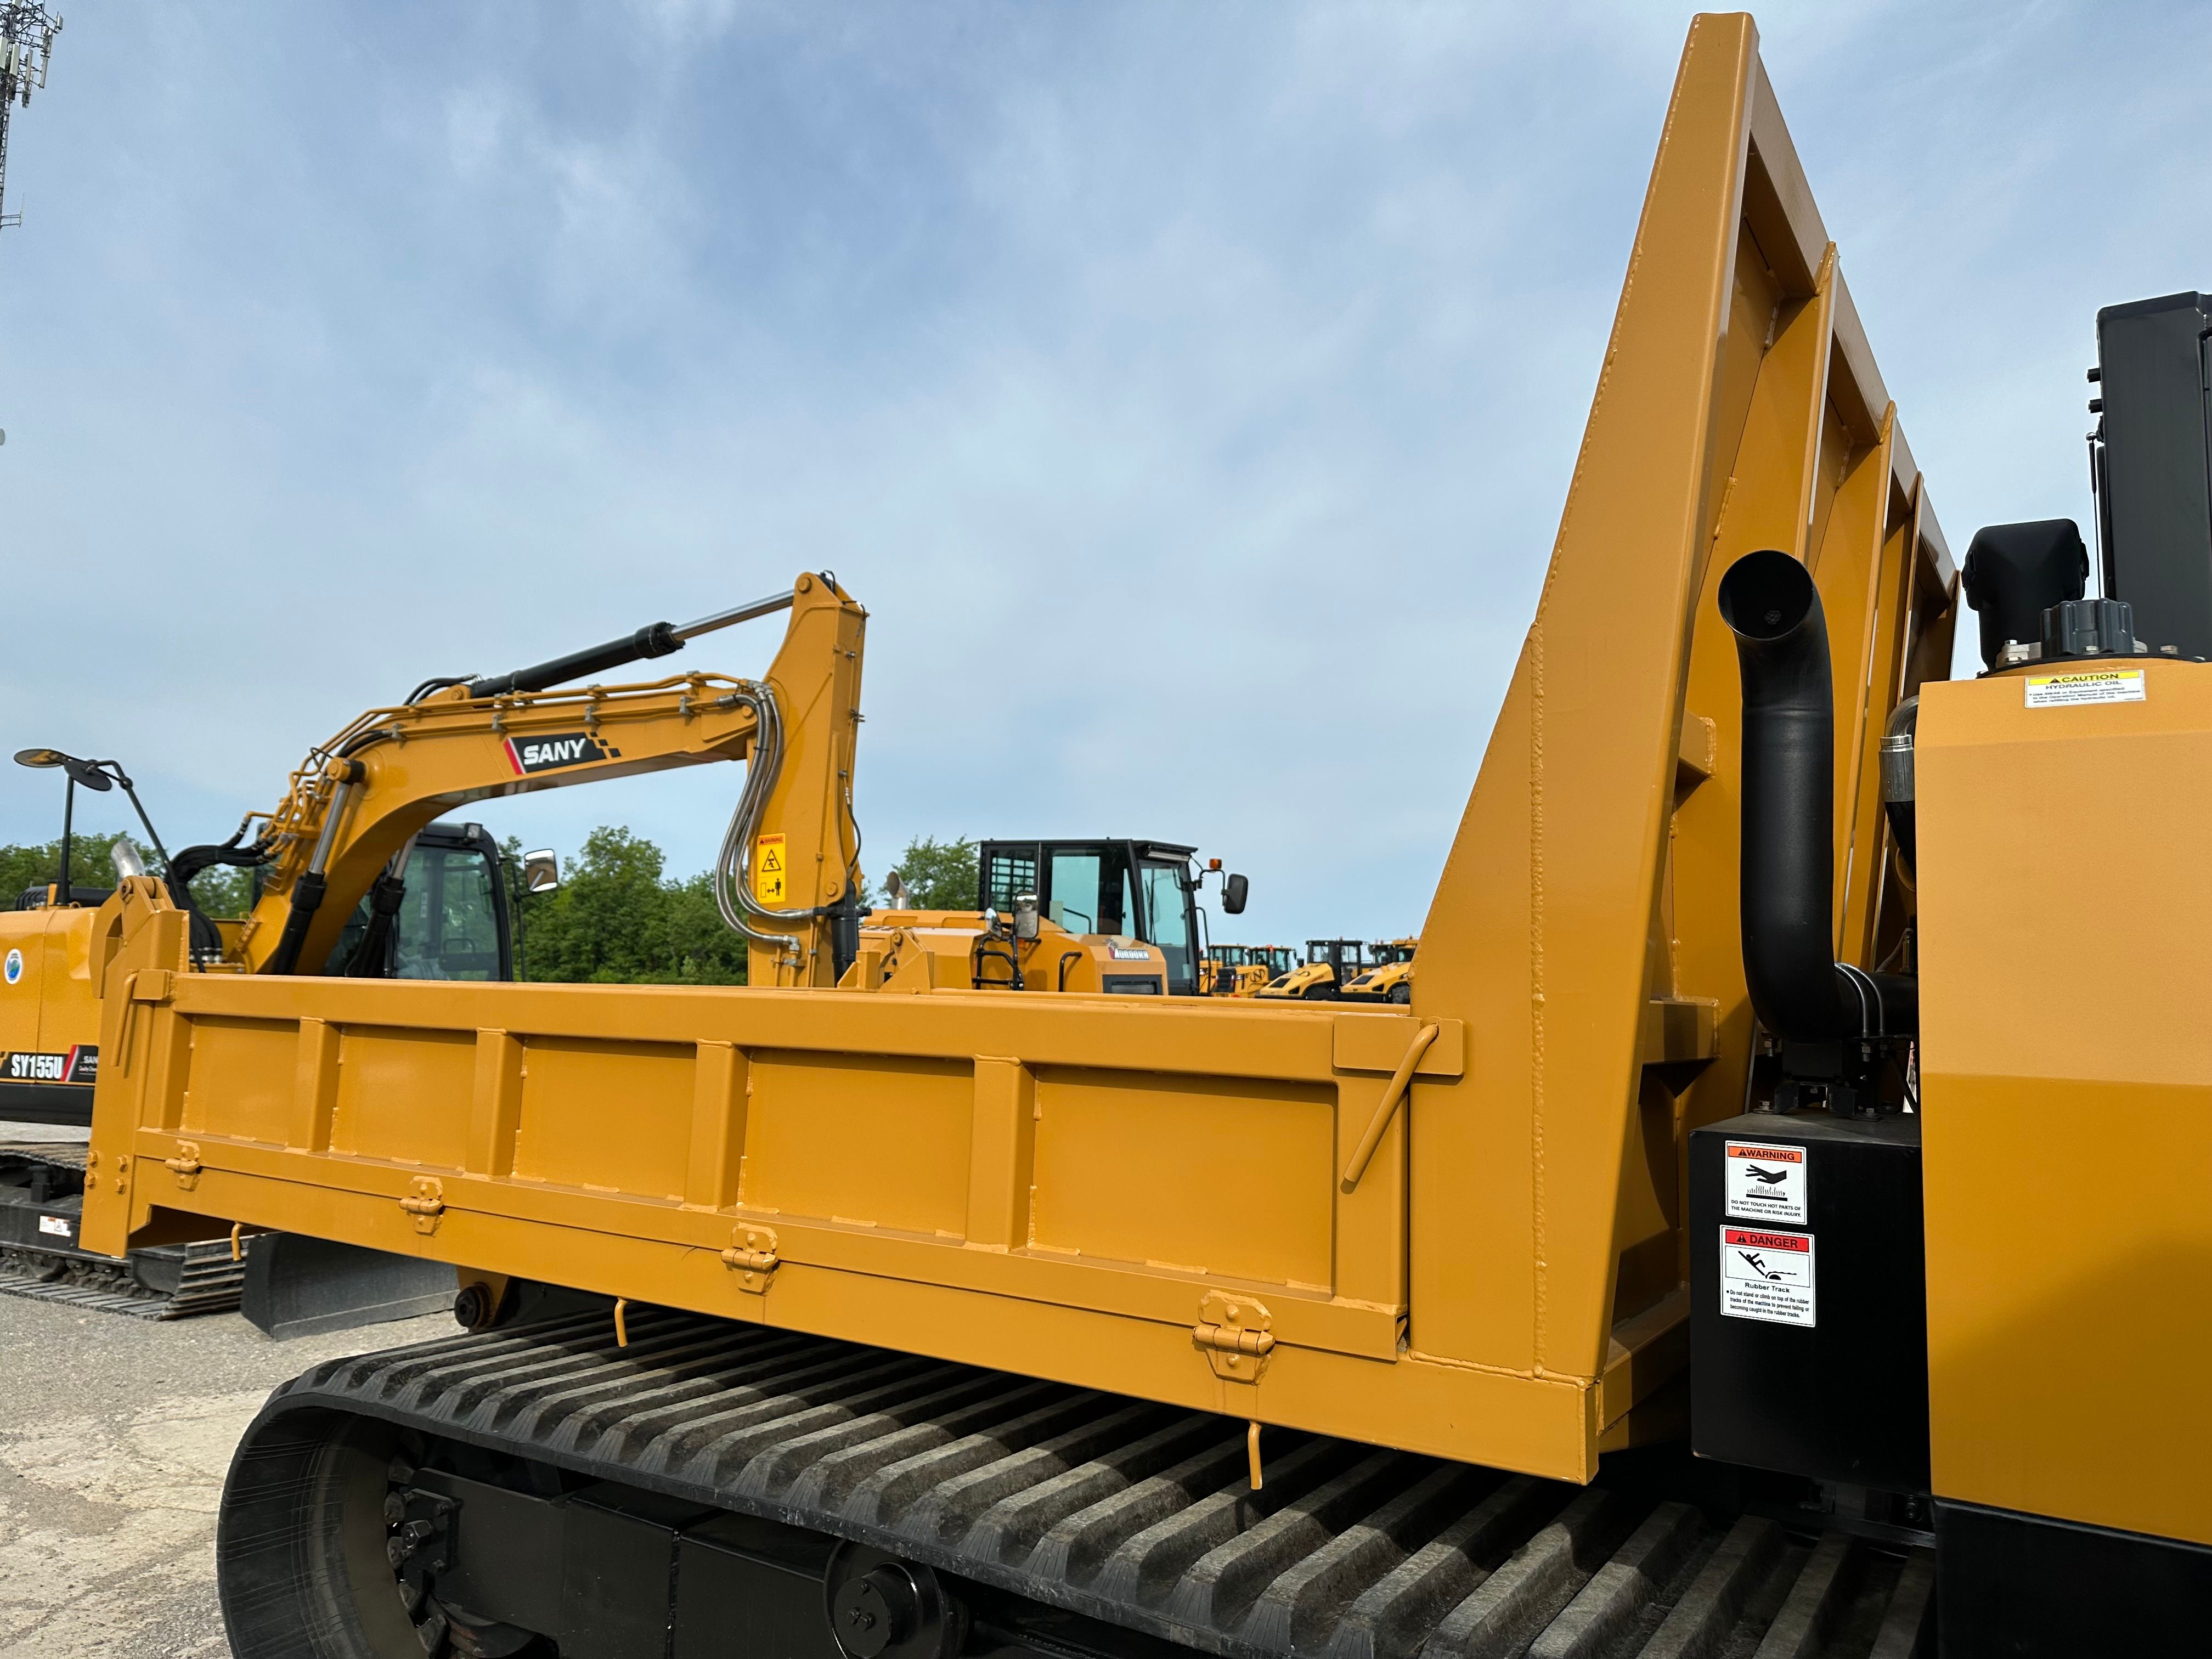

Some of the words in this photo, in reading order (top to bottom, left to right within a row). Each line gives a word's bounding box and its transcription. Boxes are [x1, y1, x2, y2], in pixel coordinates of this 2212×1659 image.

[2062, 674, 2119, 682] CAUTION
[2045, 681, 2102, 690] HYDRAULIC
[523, 737, 586, 765] SANY
[83, 1056, 98, 1064] SAN
[11, 1054, 63, 1079] SY155U
[1746, 1149, 1795, 1160] WARNING
[1750, 1234, 1798, 1249] DANGER
[1745, 1282, 1770, 1290] Rubber
